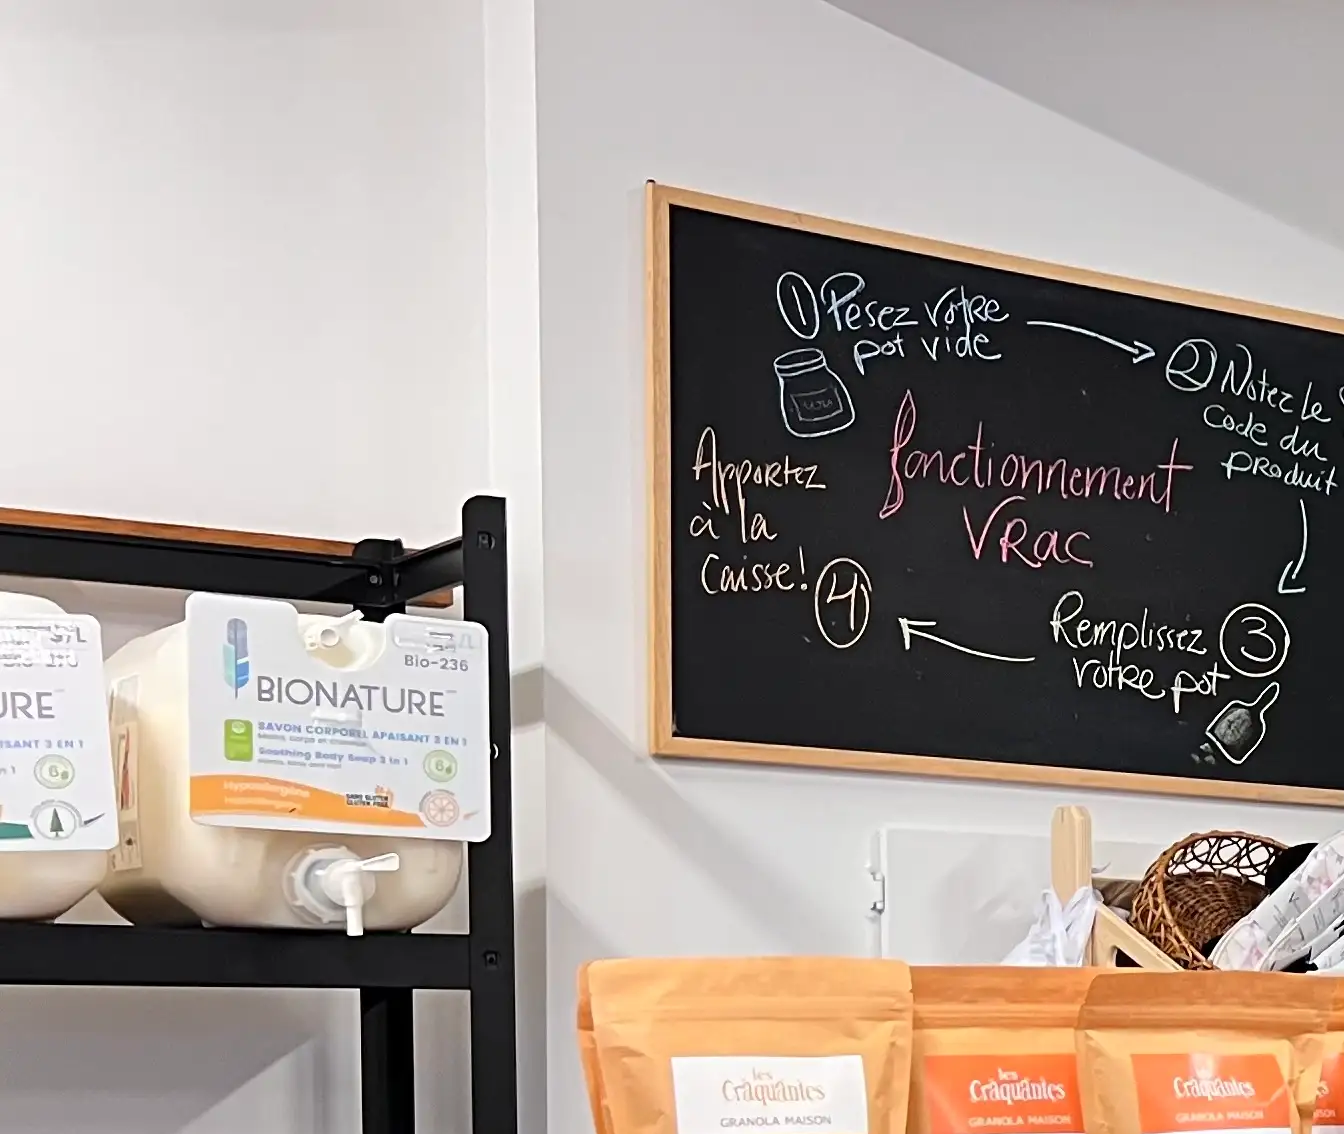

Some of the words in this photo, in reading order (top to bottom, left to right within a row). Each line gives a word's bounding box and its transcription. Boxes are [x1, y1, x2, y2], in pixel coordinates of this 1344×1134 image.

[821, 272, 918, 332] Pesez
[853, 333, 905, 376] pot
[920, 324, 1002, 361] vide
[1220, 344, 1294, 413] Notez
[878, 388, 1195, 520] fonctionnement
[1280, 425, 1329, 461] du
[692, 426, 827, 516] Apportez
[689, 501, 721, 540] à
[741, 498, 778, 543] la
[1050, 590, 1208, 664] Remplissez
[404, 654, 469, 672] Bio-236
[1170, 661, 1231, 713] pot
[257, 675, 446, 718] BIONATURE
[720, 1116, 780, 1128] GRANOLA
[785, 1114, 832, 1126] MAISON
[968, 1116, 1024, 1128] GRANOLA
[1028, 1114, 1072, 1126] MAISON
